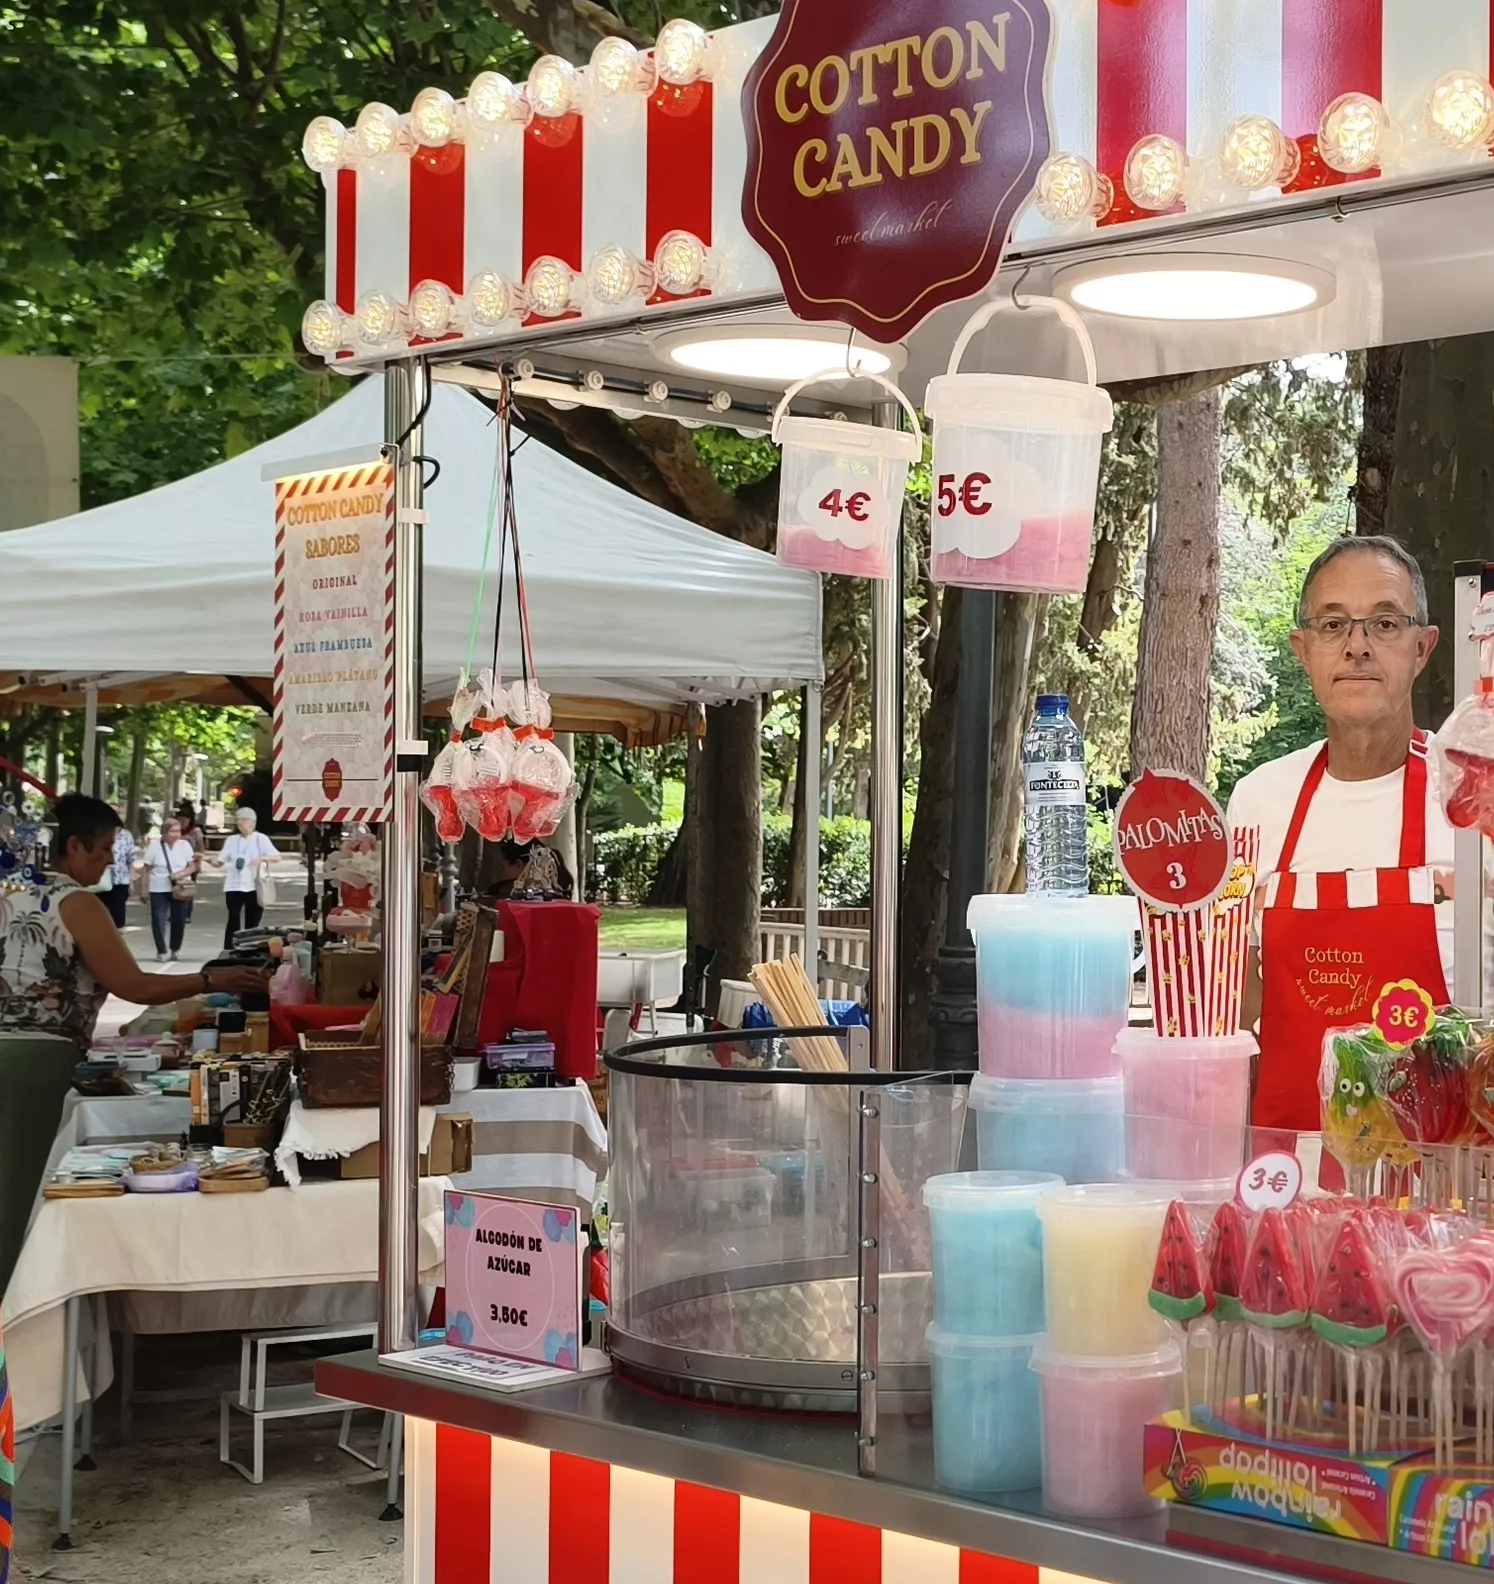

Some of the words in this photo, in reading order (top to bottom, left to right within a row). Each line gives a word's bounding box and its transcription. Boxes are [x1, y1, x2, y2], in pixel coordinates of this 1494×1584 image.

[775, 12, 1011, 123] COTTON
[793, 100, 993, 198] CANDY
[833, 211, 888, 247] sweet
[880, 198, 954, 239] market
[818, 488, 872, 522] 4€
[937, 471, 993, 518] 5€
[287, 500, 337, 526] COTTON
[340, 492, 384, 519] CANDY
[305, 533, 360, 560] SABORES
[312, 575, 357, 590] ORIGINAL
[299, 611, 322, 622] ROSA
[325, 606, 368, 620] VAINILLA
[294, 642, 316, 654] AZUL
[320, 637, 372, 652] FRAMBUESA
[288, 672, 333, 685] AMARILLO
[295, 704, 323, 715] VERDE
[327, 701, 370, 713] MANZANA
[1117, 810, 1223, 856] PALOMITAS
[1166, 862, 1187, 890] 3
[1304, 947, 1364, 964] Cotton
[1308, 968, 1363, 989] Candy
[1324, 974, 1374, 1017] market
[1389, 1004, 1420, 1028] 3€
[475, 1228, 525, 1250] ALGODÓN
[528, 1236, 543, 1253] DE
[487, 1254, 531, 1277] AZÚCAR
[490, 1303, 528, 1327] 3,50€
[1219, 1442, 1317, 1494] lollipop
[1231, 1479, 1343, 1523] rainbow
